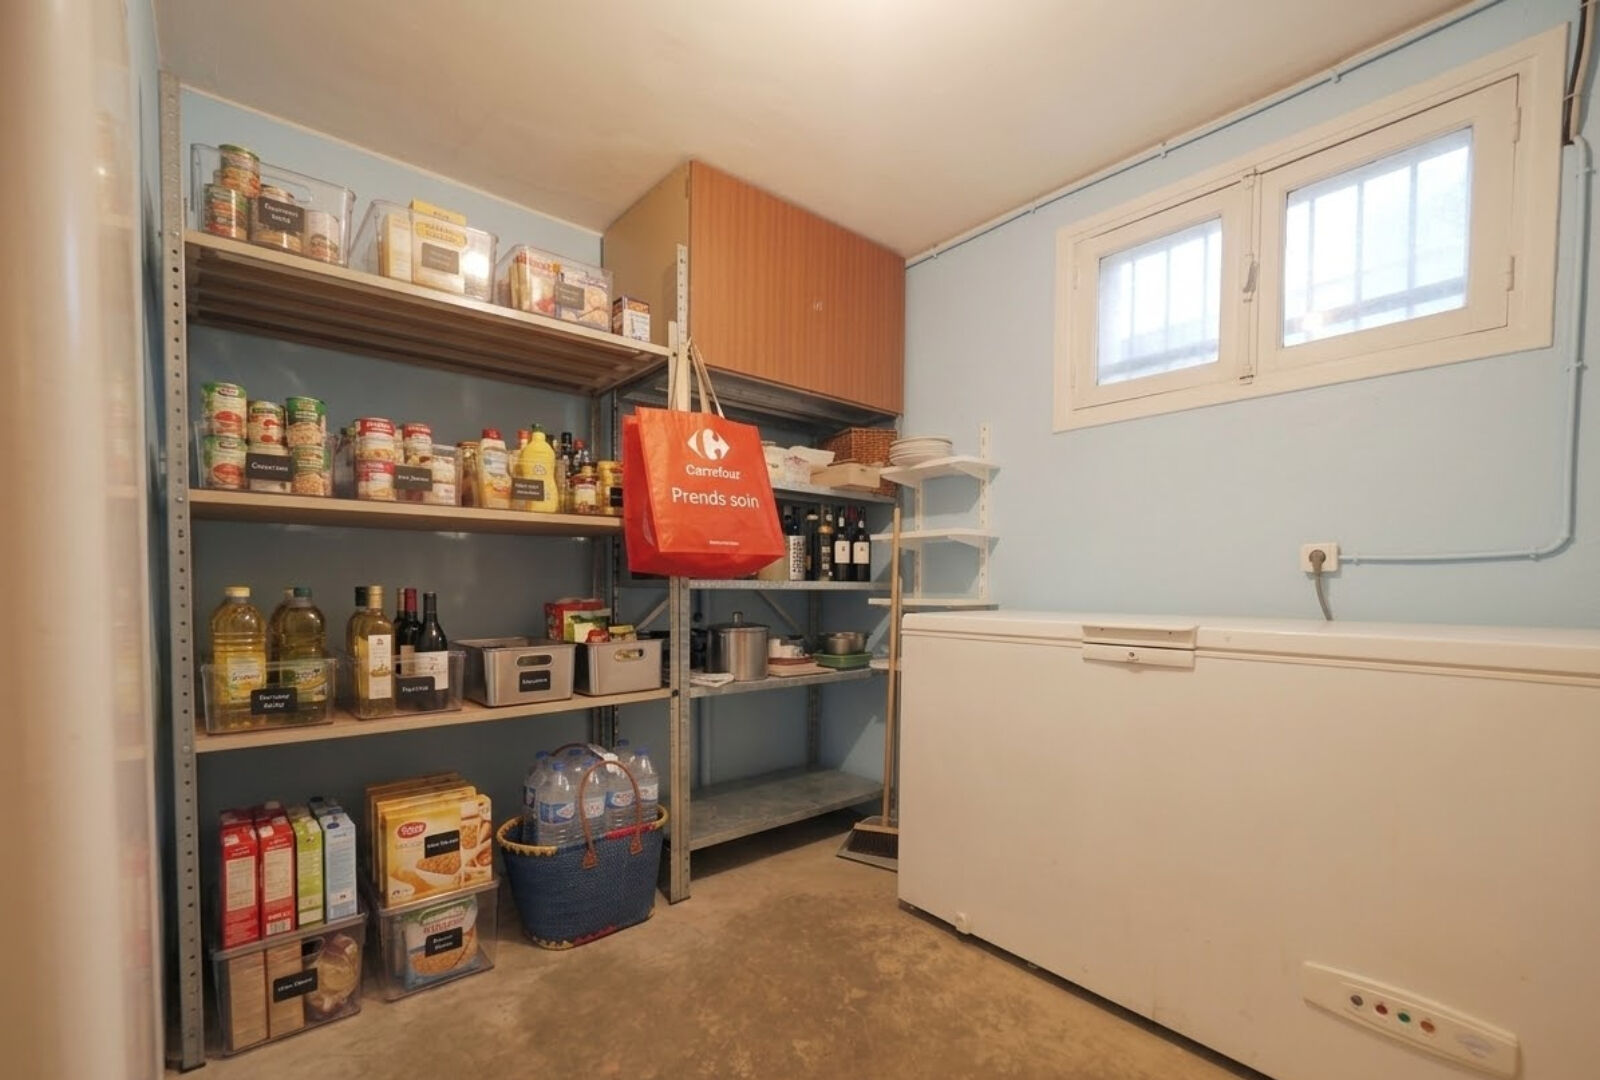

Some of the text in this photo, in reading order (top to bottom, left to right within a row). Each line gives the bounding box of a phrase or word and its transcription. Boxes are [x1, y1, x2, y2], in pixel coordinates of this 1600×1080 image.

[686, 464, 741, 480] Carrefour
[671, 487, 760, 508] Prends soin
